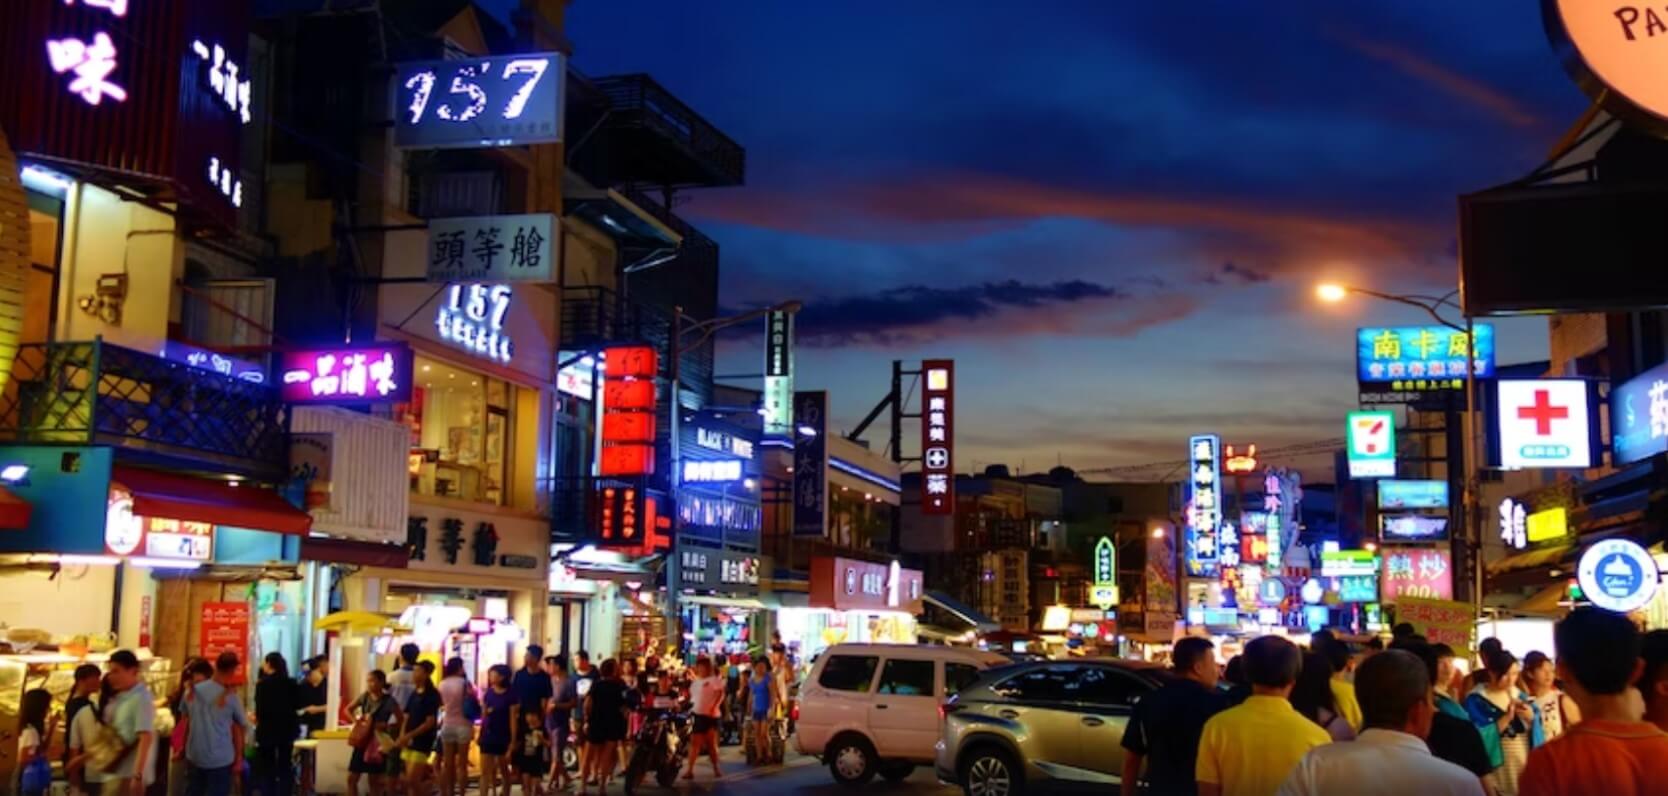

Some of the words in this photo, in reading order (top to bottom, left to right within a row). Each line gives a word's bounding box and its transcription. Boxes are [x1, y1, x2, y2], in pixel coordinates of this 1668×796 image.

[1613, 6, 1668, 41] PA
[46, 0, 128, 105] 味
[405, 58, 549, 123] 157
[432, 225, 545, 270] 頭等艙
[449, 283, 512, 330] 157
[284, 352, 397, 396] 一品滷味
[697, 427, 723, 451] BLACK
[1387, 553, 1447, 580] 熱炒
